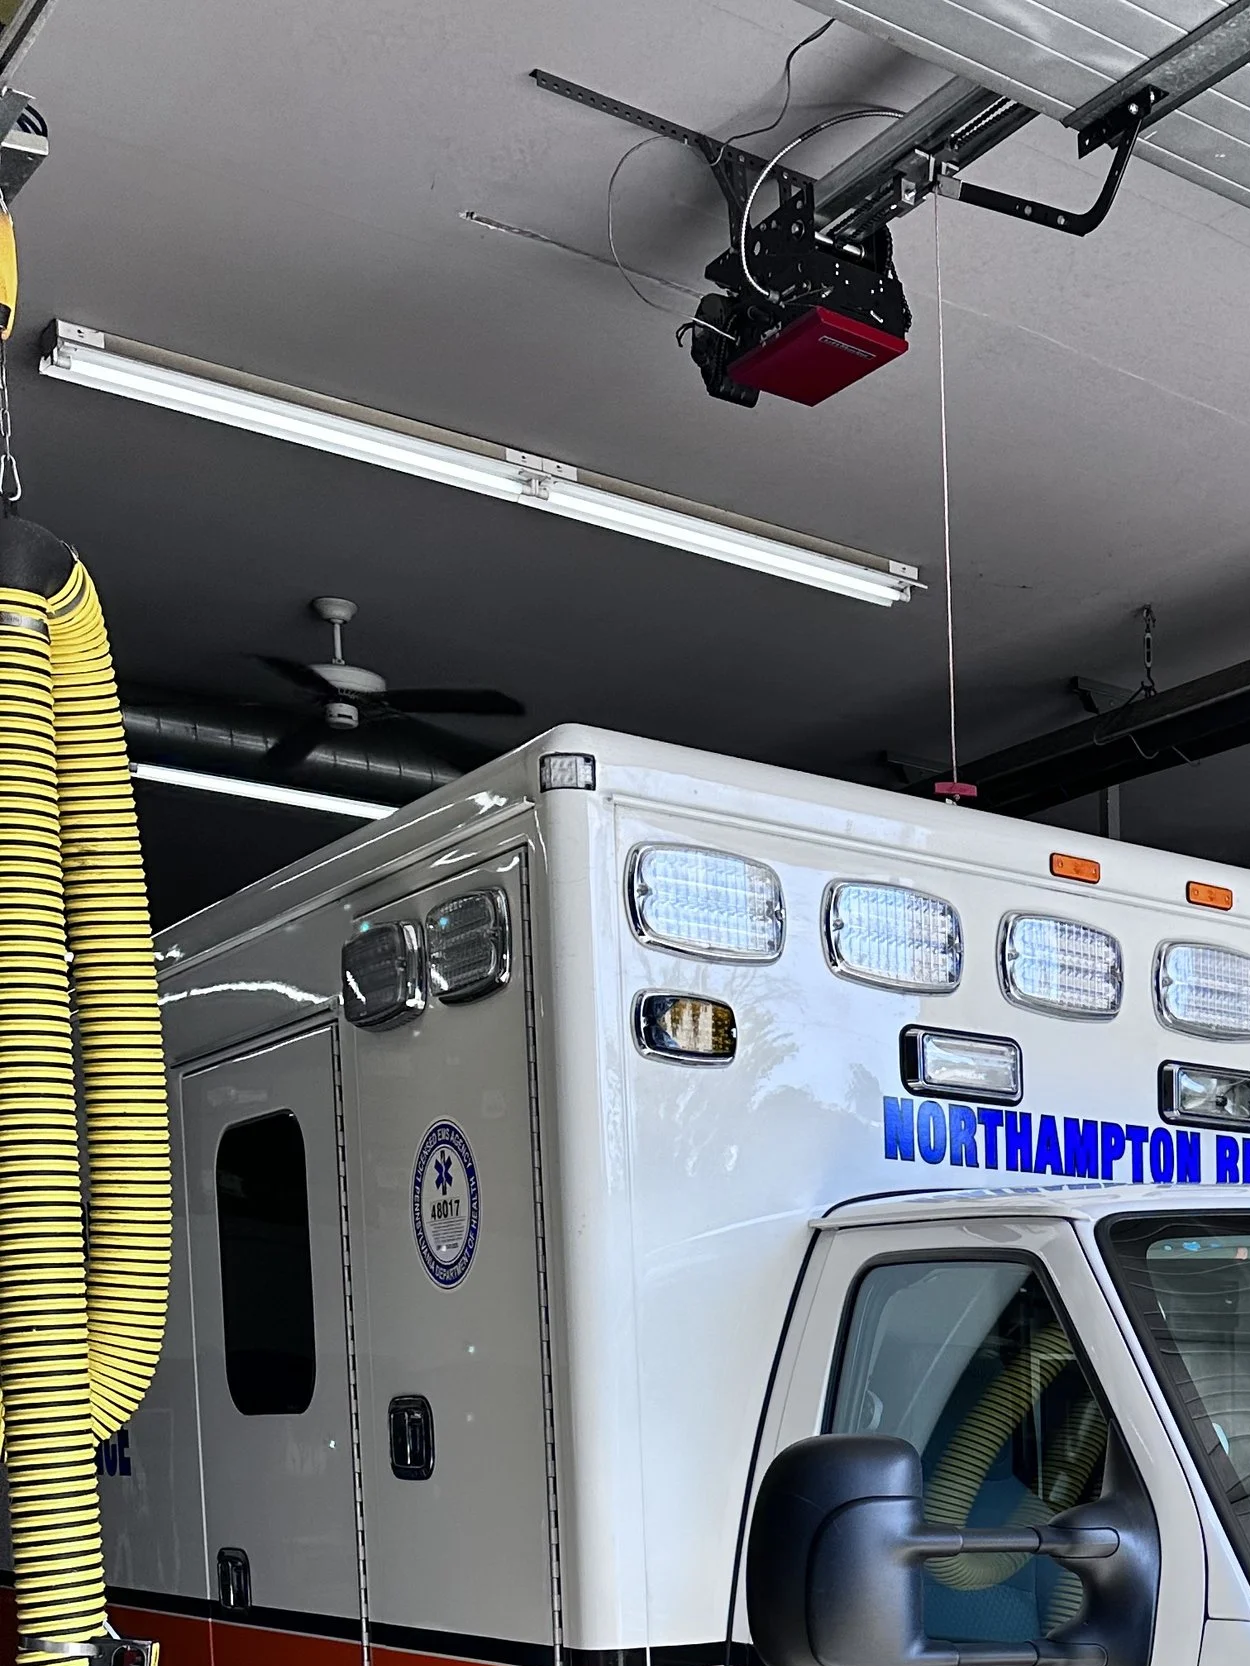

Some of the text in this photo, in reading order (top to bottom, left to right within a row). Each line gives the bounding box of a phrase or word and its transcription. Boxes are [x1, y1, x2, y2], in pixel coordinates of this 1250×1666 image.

[415, 1126, 473, 1182] LICENSED EMS AGENCY
[883, 1096, 1201, 1184] NORTHAMPTON
[413, 1186, 436, 1273] PENNSYLVANIA
[431, 1199, 460, 1220] 48017
[469, 1175, 479, 1230] HEALTH
[434, 1246, 471, 1281] DEPARTMENT
[467, 1229, 475, 1250] OF
